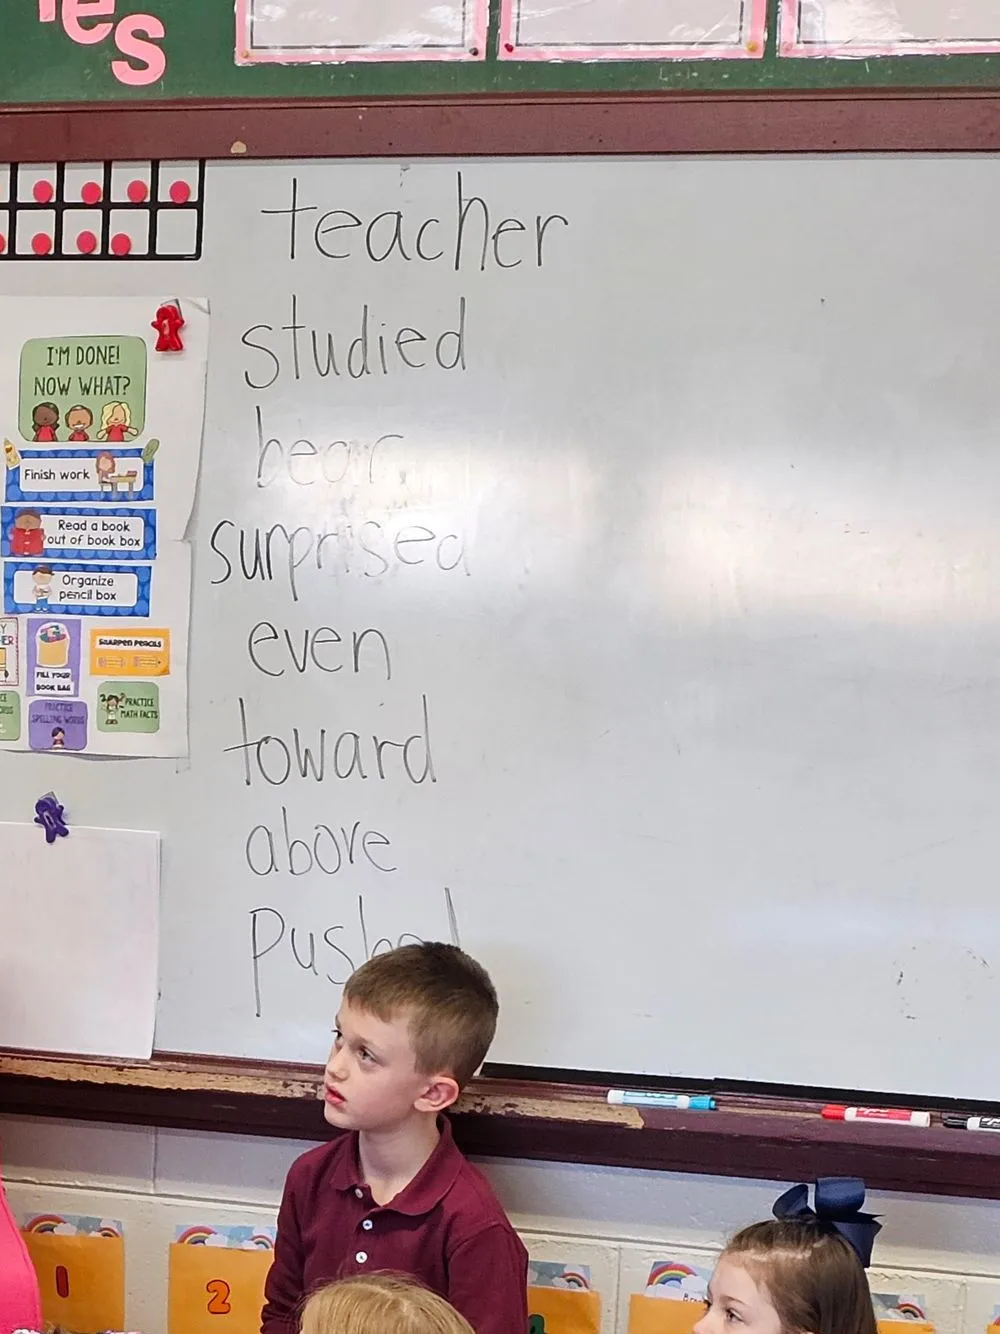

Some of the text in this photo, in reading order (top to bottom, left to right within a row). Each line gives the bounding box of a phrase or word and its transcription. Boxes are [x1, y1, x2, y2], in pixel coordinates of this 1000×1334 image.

[261, 171, 568, 271] teacher
[46, 345, 121, 366] I'M DONE!
[241, 294, 466, 389] studied
[33, 375, 131, 397] NOW WHAT?
[24, 469, 90, 481] Finish work
[58, 519, 130, 532] Read a book
[47, 534, 141, 547] out of book box
[59, 589, 117, 602] pencil box
[62, 574, 114, 589] Organize
[248, 621, 391, 681] even
[223, 694, 437, 786] toward
[246, 806, 397, 876] above
[249, 887, 461, 1018] push
[206, 1279, 231, 1314] 2
